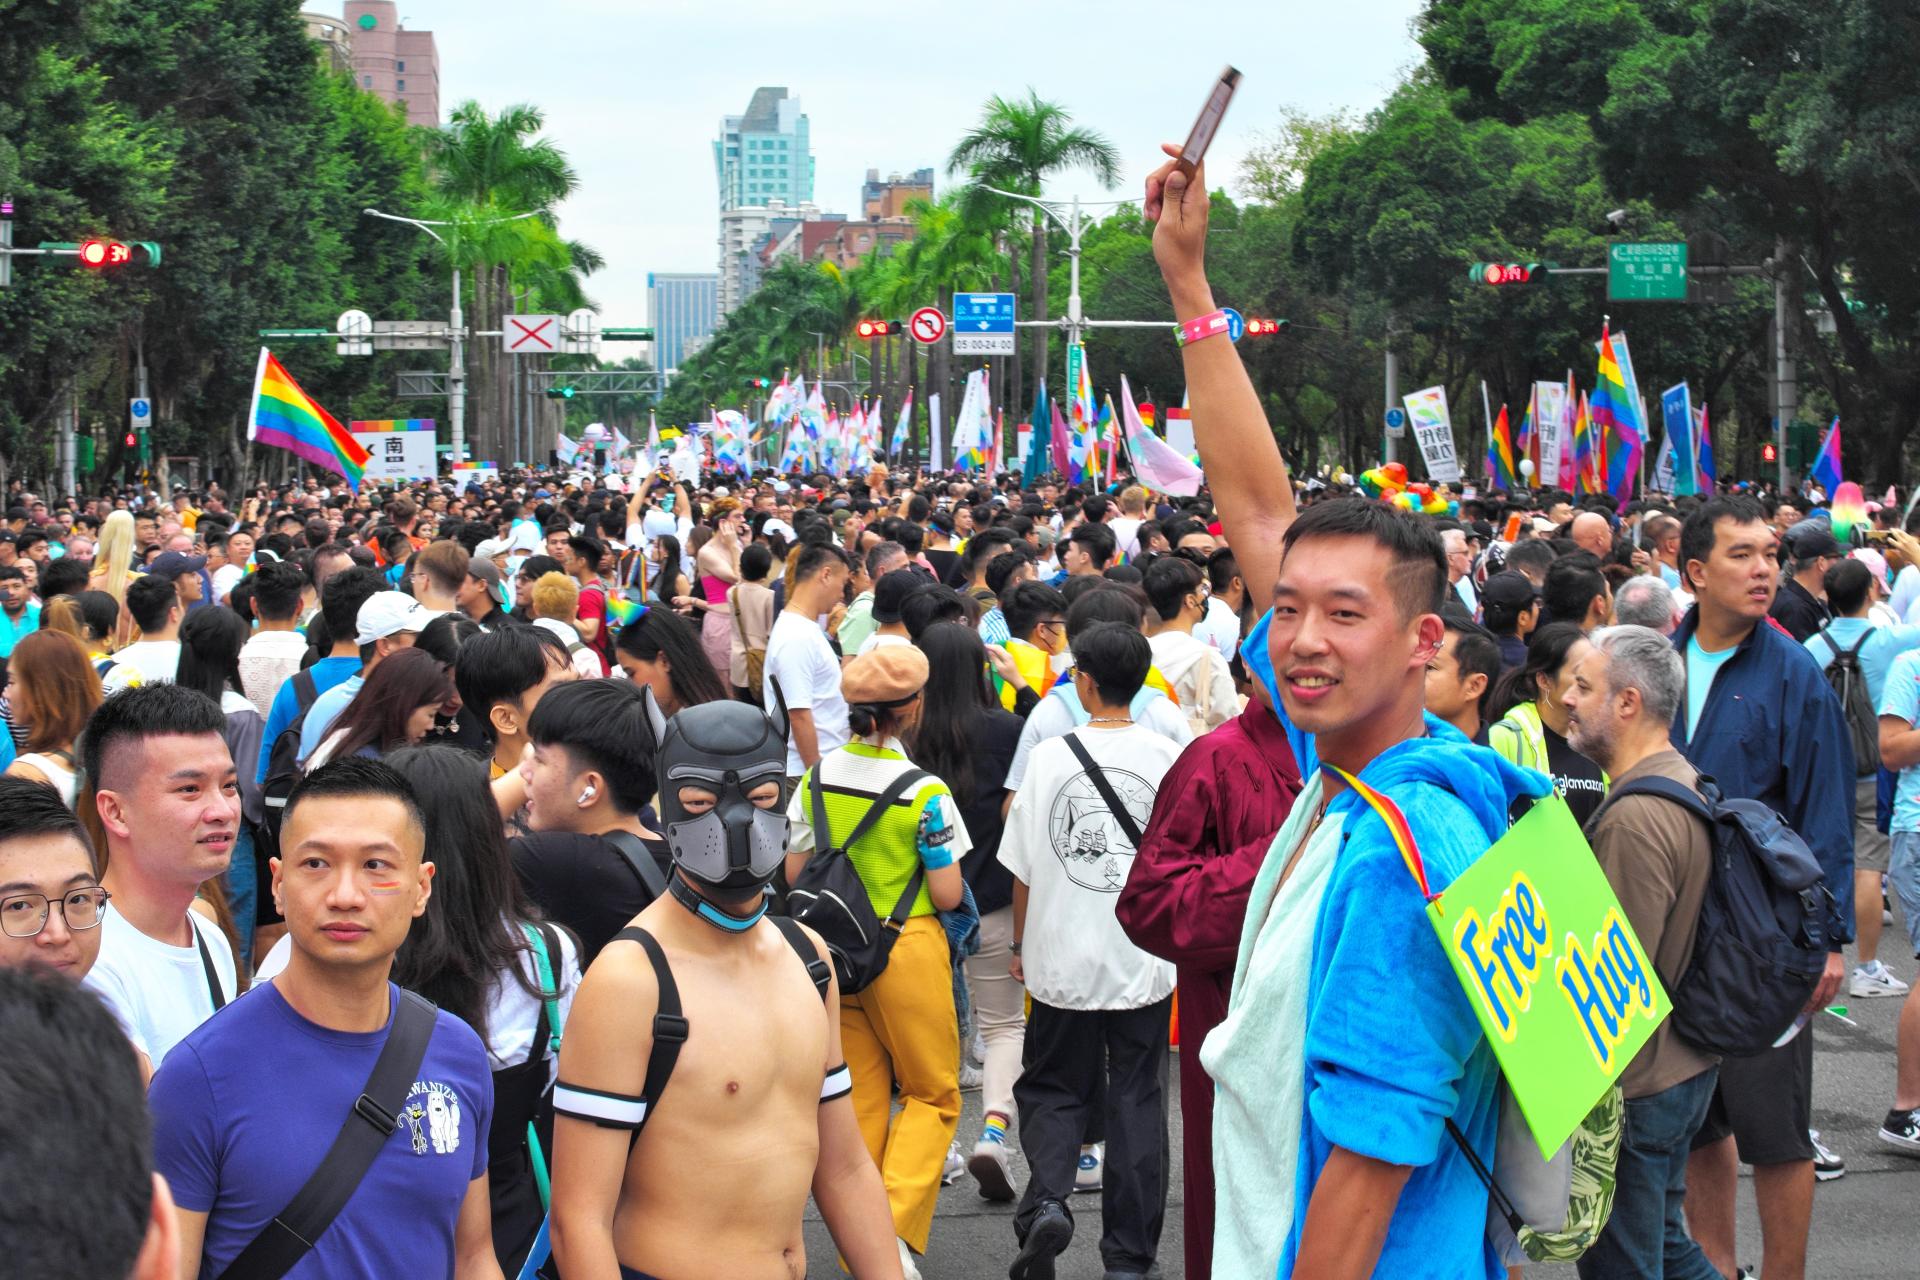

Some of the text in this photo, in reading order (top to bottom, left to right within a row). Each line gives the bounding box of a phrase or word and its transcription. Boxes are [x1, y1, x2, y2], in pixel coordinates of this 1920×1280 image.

[385, 437, 403, 455] 南
[1459, 880, 1548, 1034] Free
[1560, 917, 1652, 1067] Hug
